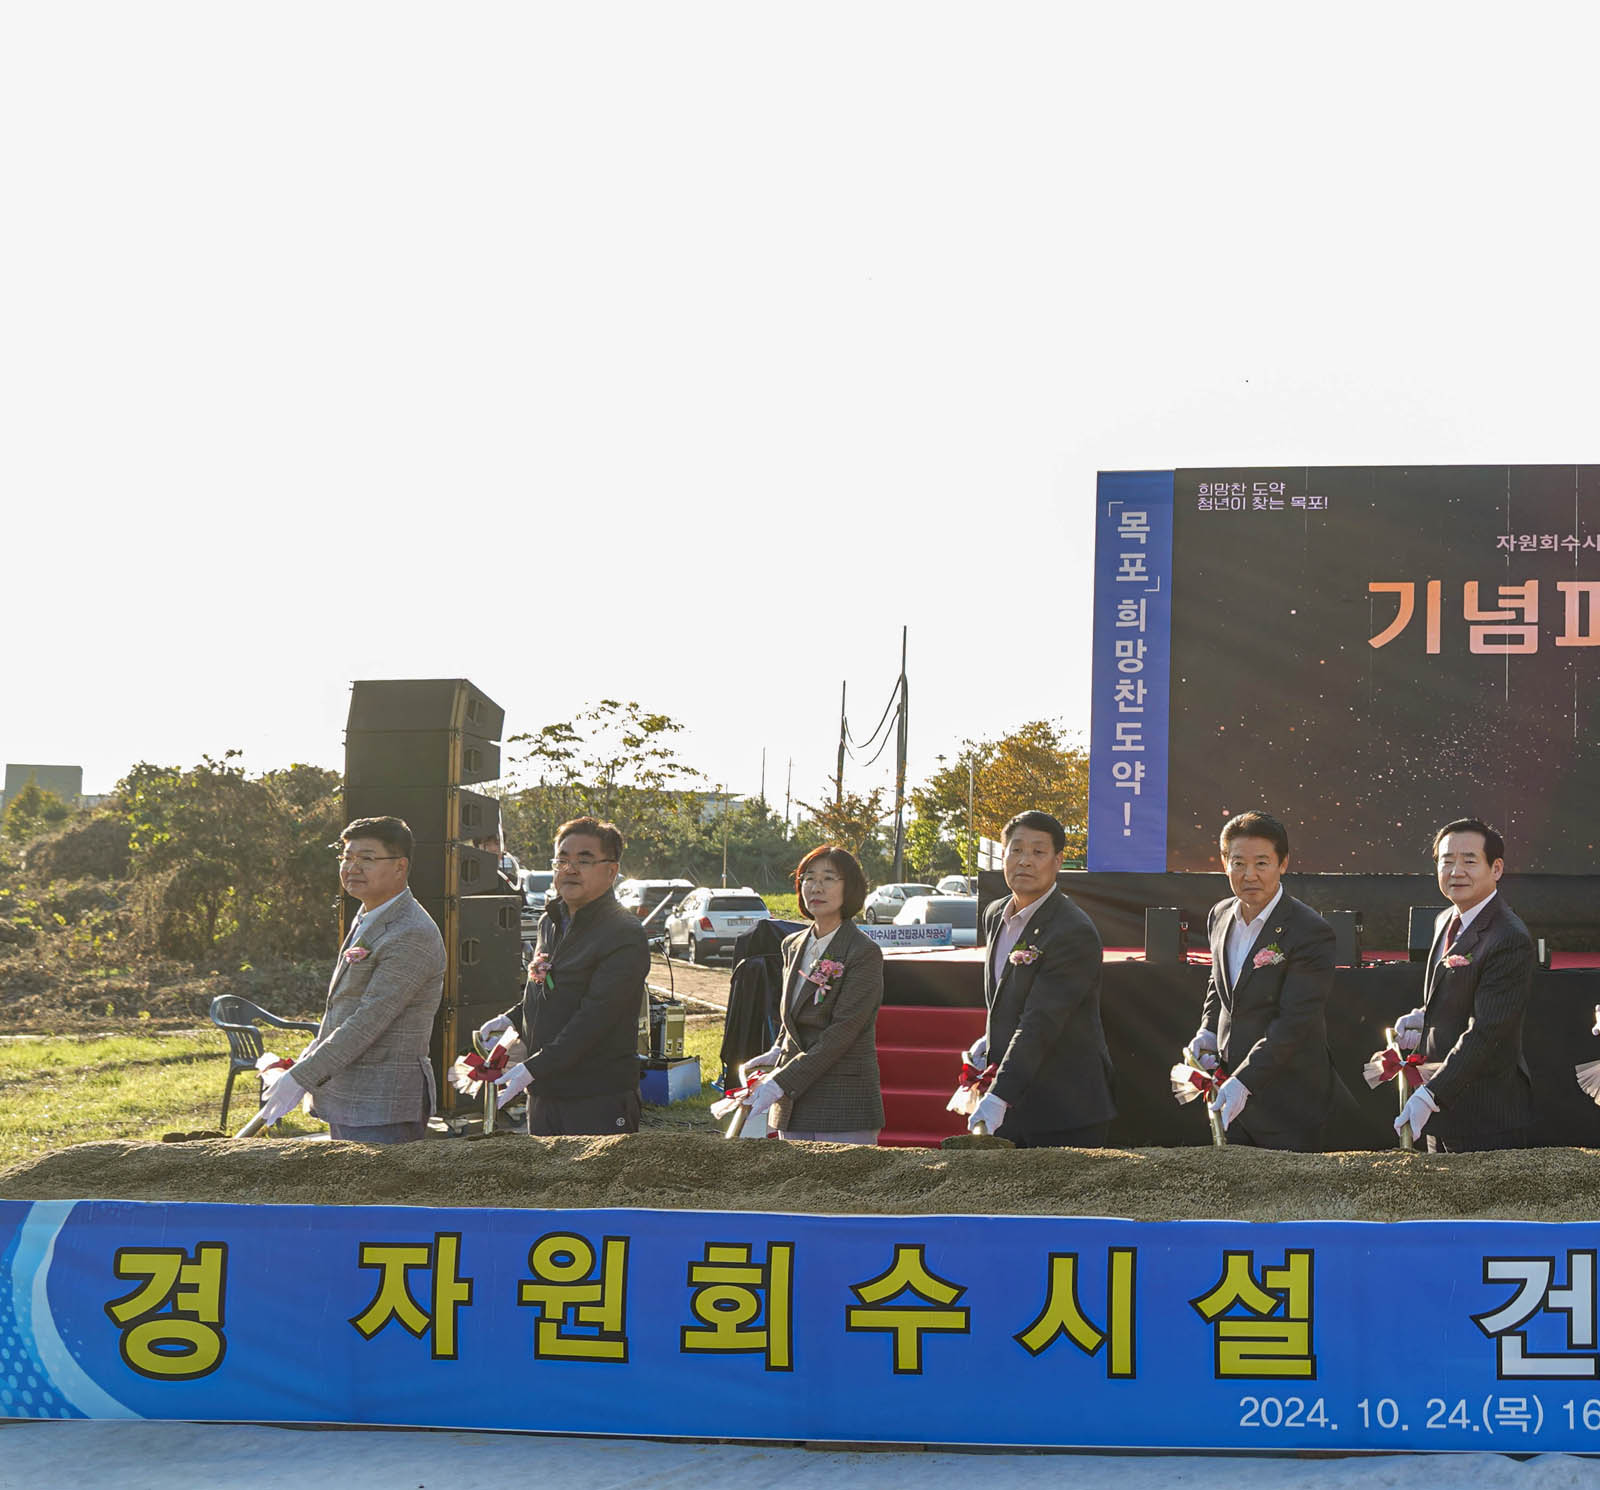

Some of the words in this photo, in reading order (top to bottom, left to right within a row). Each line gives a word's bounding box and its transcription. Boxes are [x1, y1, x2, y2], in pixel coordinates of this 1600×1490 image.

[1197, 482, 1247, 497] 희망찬
[1252, 481, 1286, 496] 도약
[1197, 496, 1246, 511] 청년이
[1252, 496, 1285, 511] 찾는
[1290, 496, 1328, 510] 목포!
[863, 928, 897, 940] 회수시설
[104, 1240, 229, 1381] 경
[348, 1231, 1317, 1380] 자원회수시설
[1239, 1396, 1338, 1431] 2024.
[1357, 1397, 1409, 1431] 10.
[1426, 1394, 1544, 1435] 24.(목)
